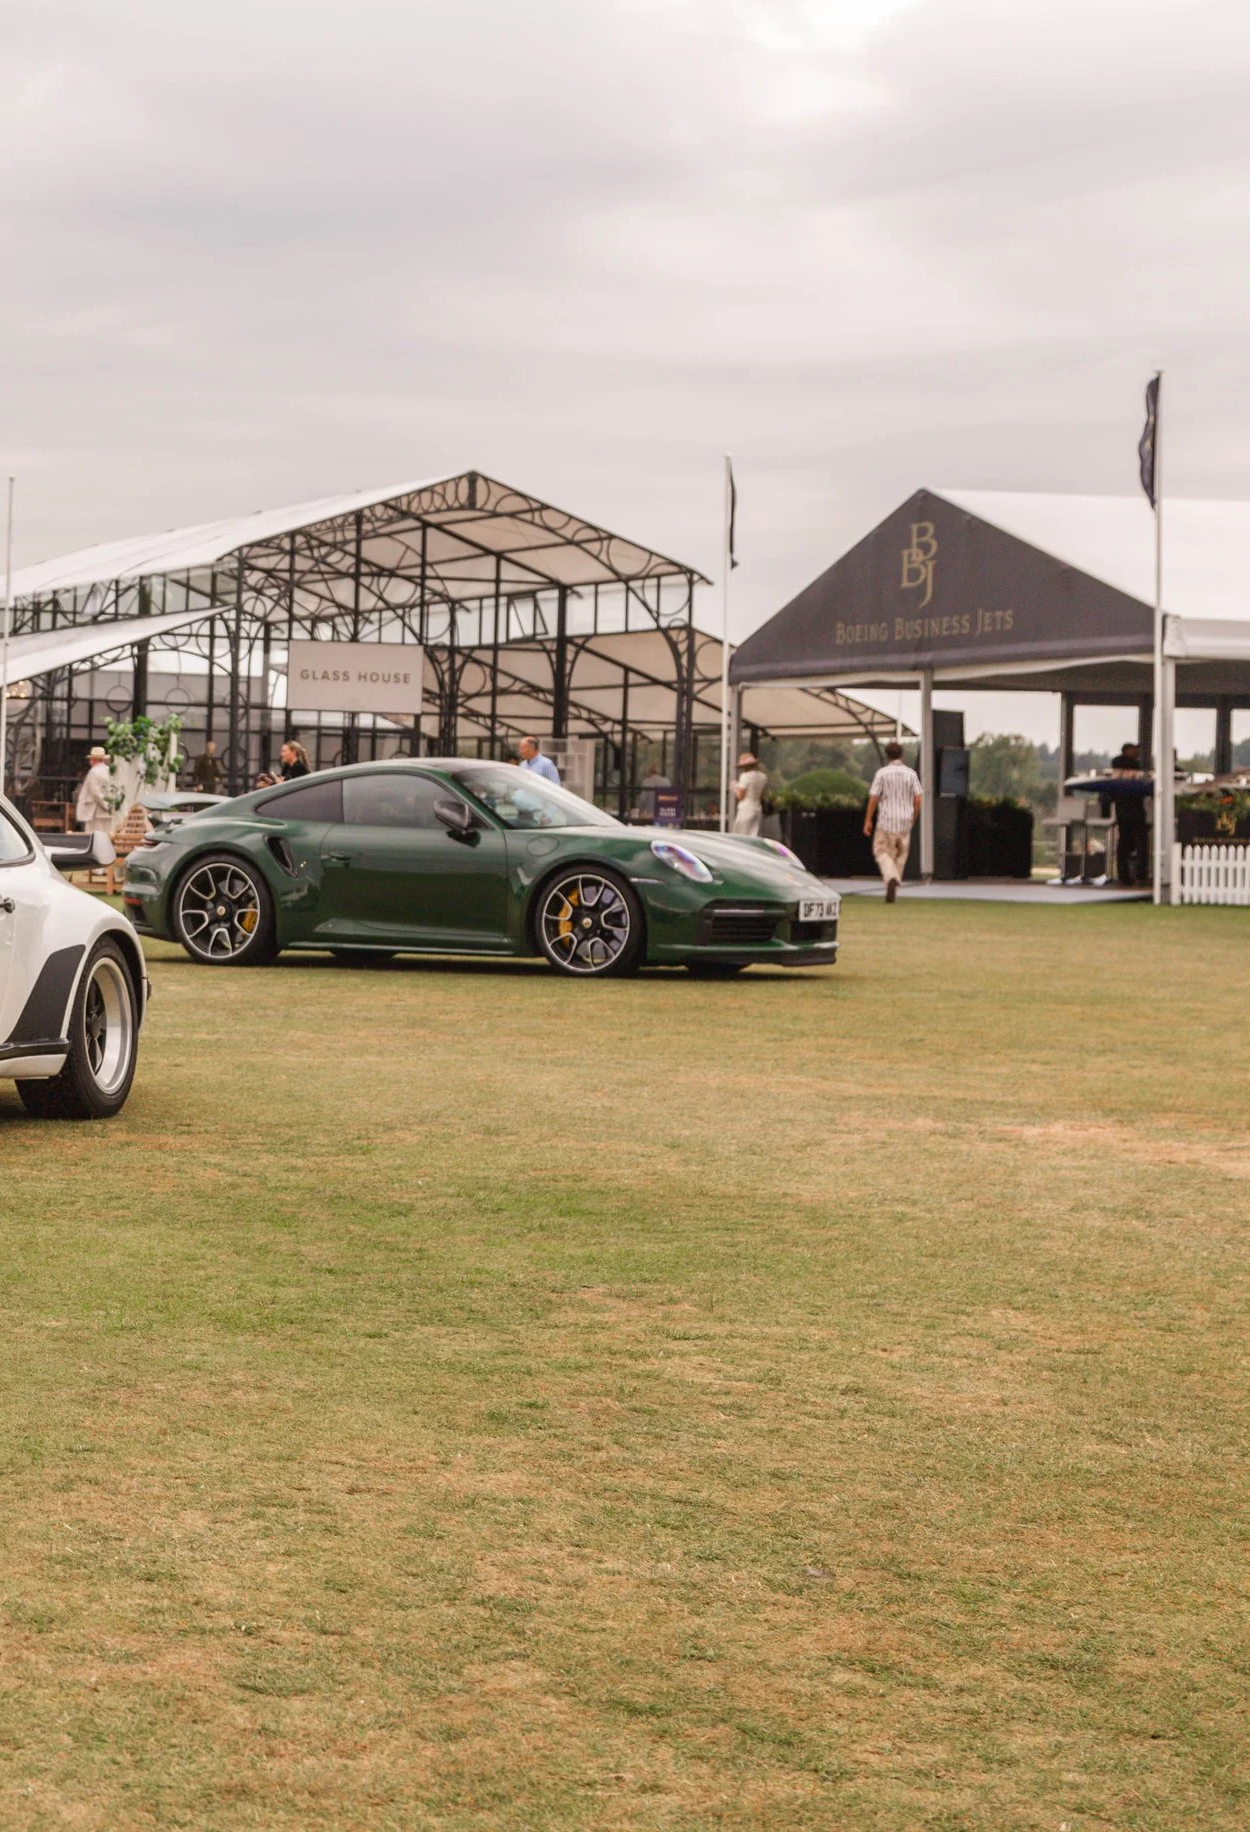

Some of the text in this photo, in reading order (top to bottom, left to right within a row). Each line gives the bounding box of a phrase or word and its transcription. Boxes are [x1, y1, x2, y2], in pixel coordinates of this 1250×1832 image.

[835, 608, 1015, 645] BOEING BUSINESS JETS
[299, 668, 412, 684] GLASS HOUSE
